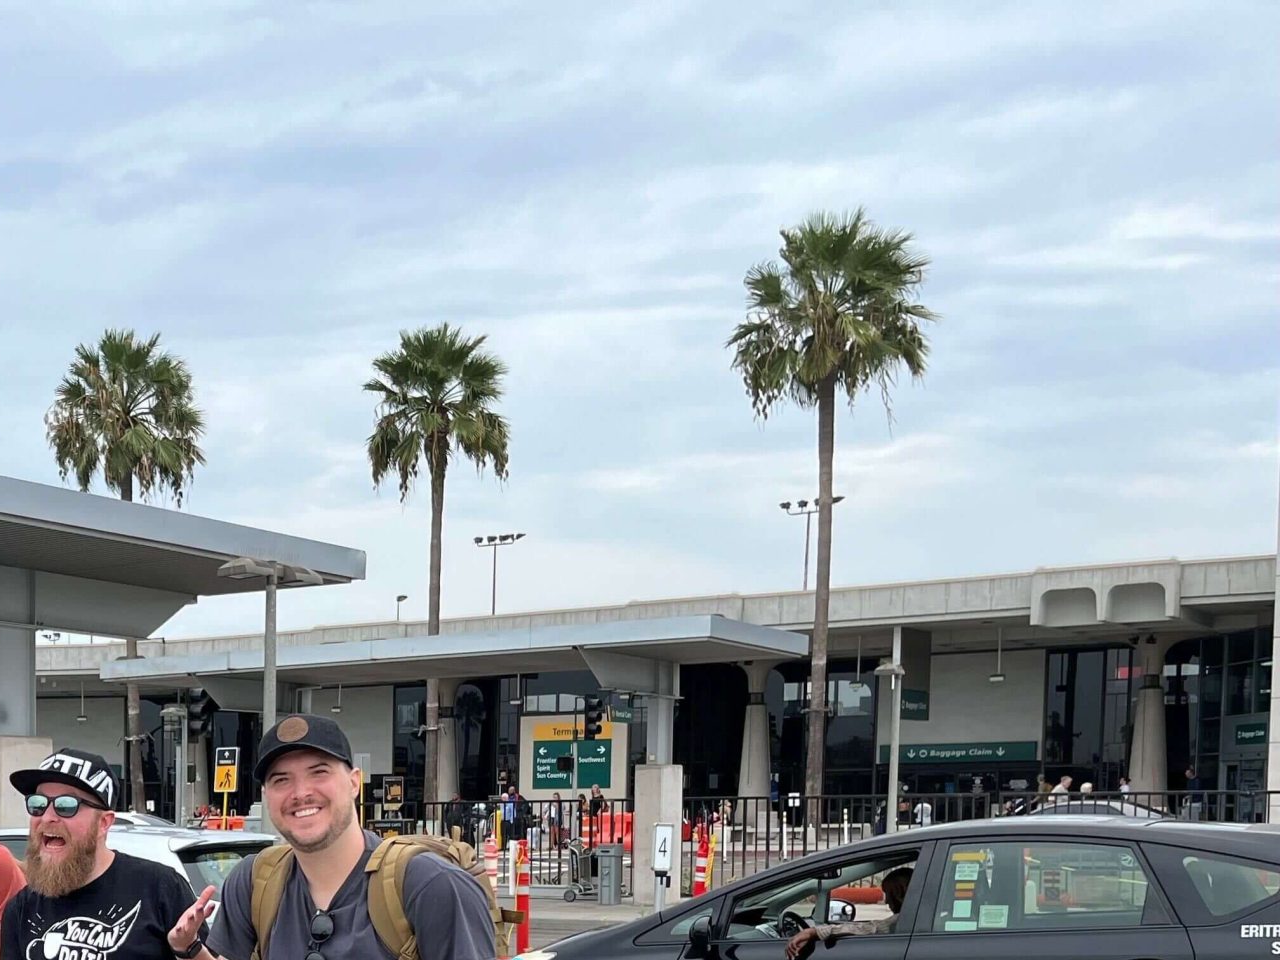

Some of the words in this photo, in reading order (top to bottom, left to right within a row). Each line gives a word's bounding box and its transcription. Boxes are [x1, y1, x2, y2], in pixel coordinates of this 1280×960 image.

[930, 750, 966, 758] Baggage
[969, 748, 992, 756] Claim
[547, 772, 567, 780] Country
[658, 837, 668, 857] 4
